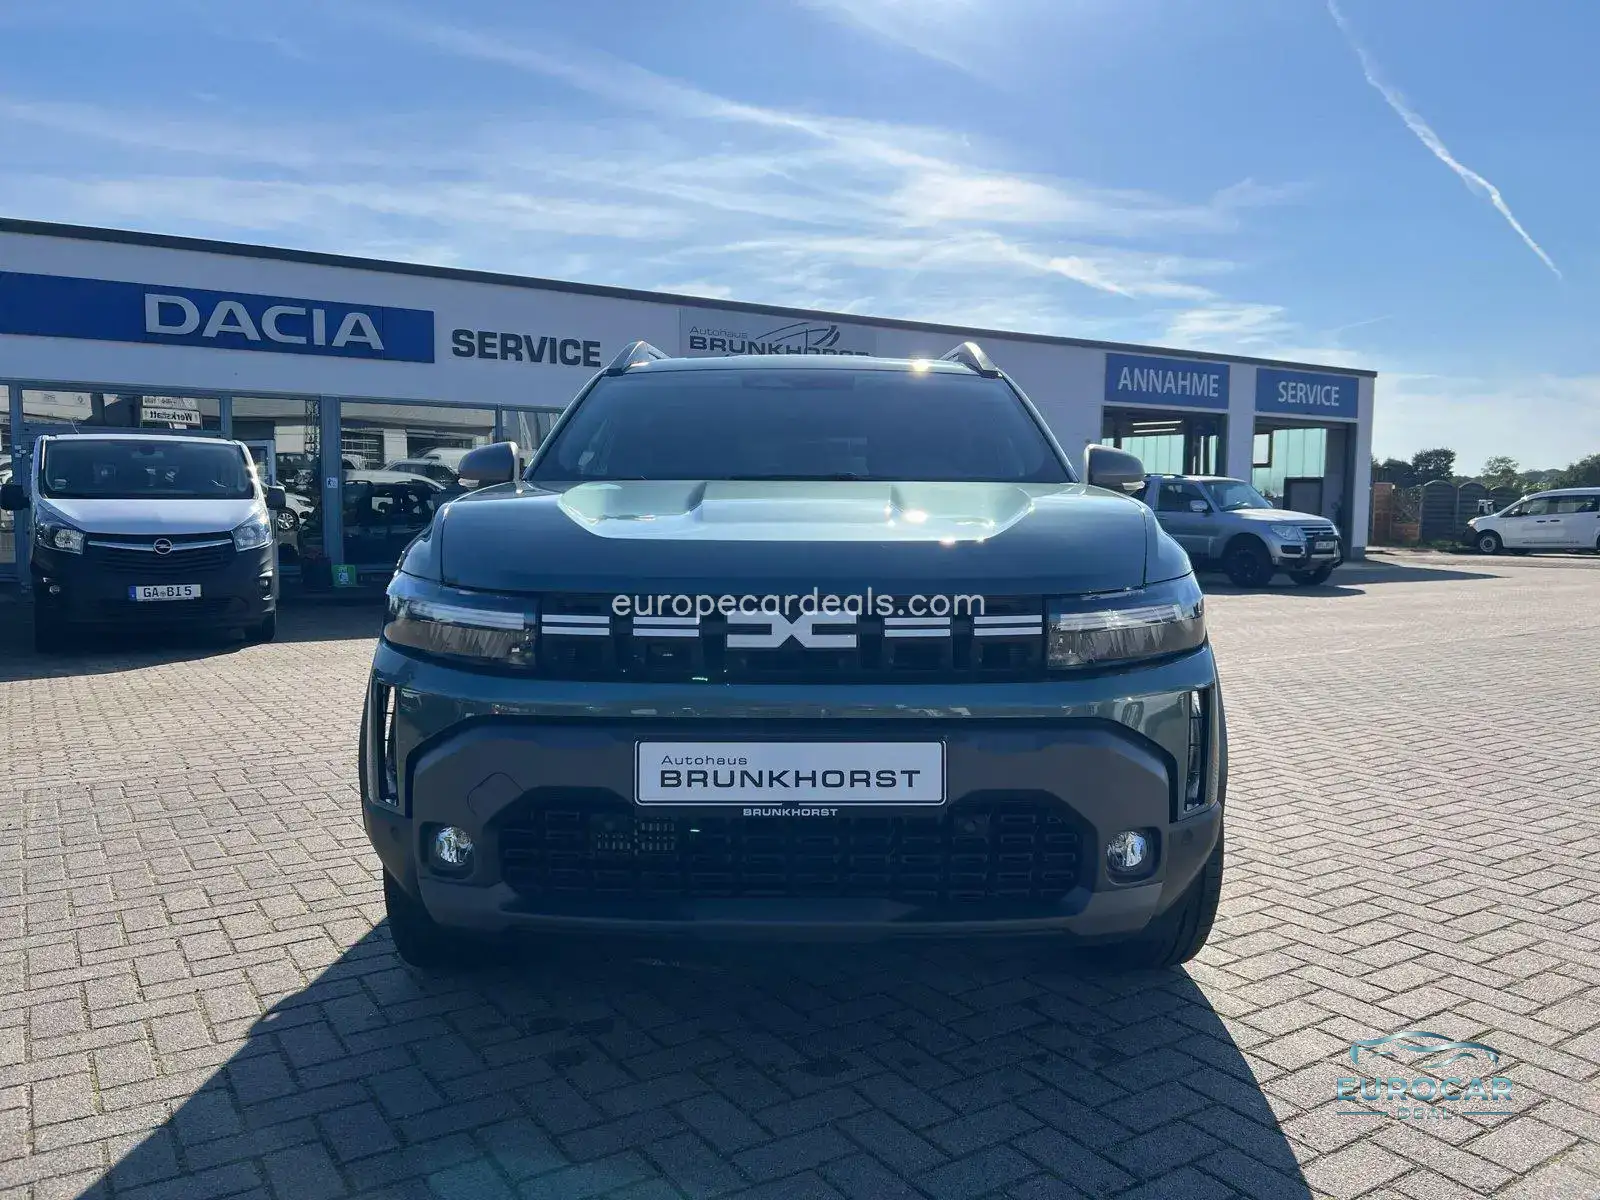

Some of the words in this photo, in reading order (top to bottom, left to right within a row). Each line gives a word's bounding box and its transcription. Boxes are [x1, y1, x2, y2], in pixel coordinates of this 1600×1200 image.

[144, 293, 384, 350] DACIA
[689, 325, 748, 339] Autohaus
[451, 328, 601, 367] SERVICE
[1118, 366, 1219, 398] ANNAHME
[1278, 381, 1340, 407] SERVICE
[143, 587, 159, 597] GA
[661, 755, 748, 765] Autohaus
[660, 769, 921, 788] BRUNKHORST
[742, 808, 838, 817] BRUNKHORST
